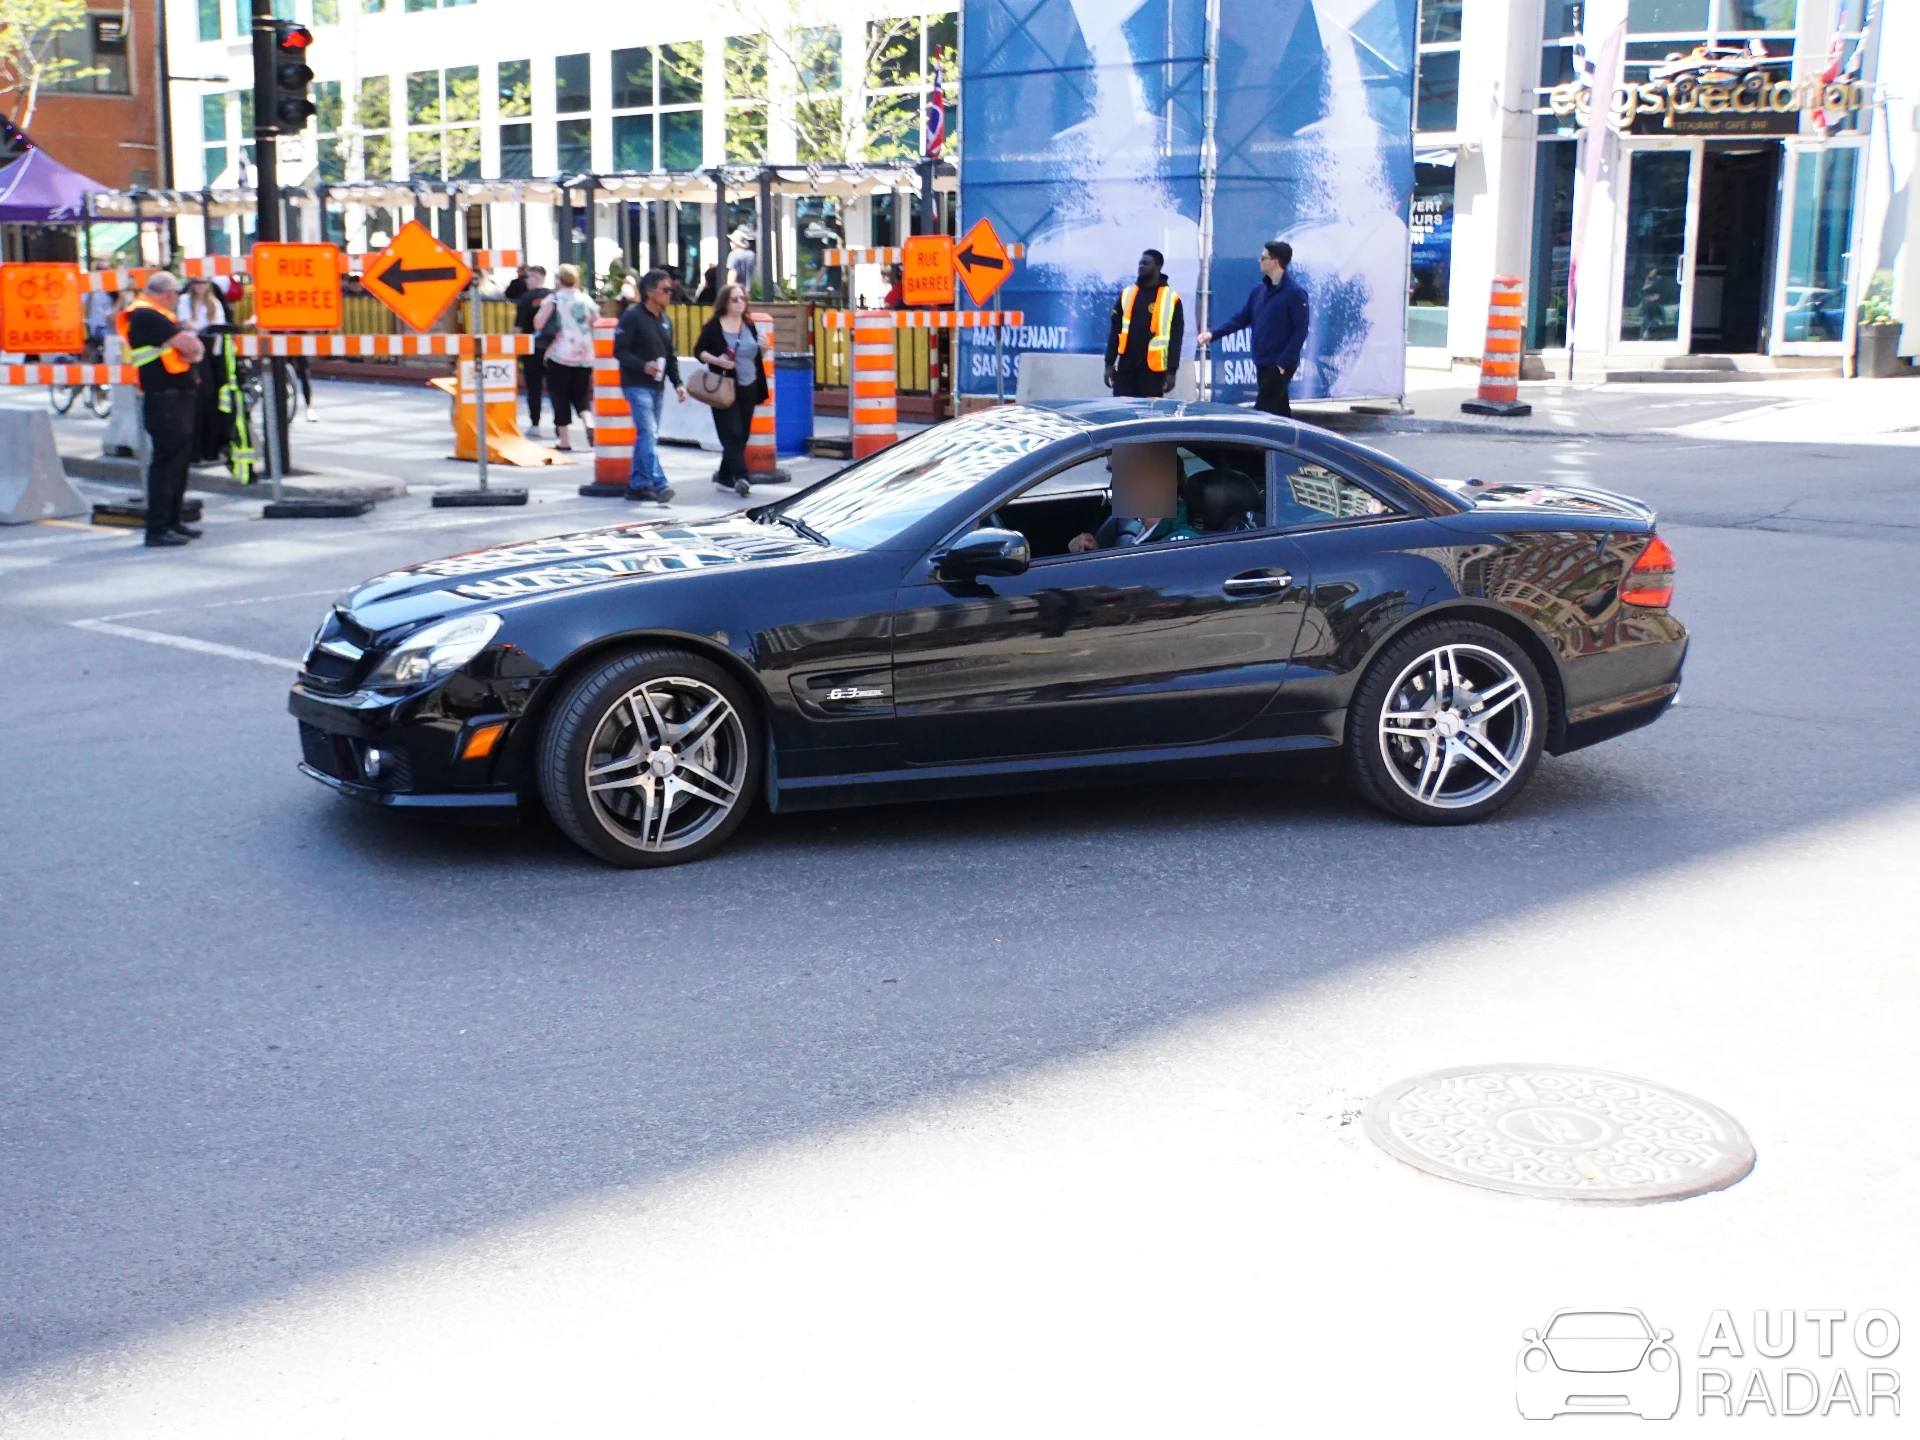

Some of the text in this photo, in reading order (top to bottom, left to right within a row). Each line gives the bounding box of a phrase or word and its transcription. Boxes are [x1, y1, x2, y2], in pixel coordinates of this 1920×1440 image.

[278, 258, 314, 277] RUE
[917, 252, 939, 267] RUE
[907, 273, 949, 293] BARRÉE
[262, 286, 333, 309] BARRÉE
[972, 325, 1068, 350] MANTENANT
